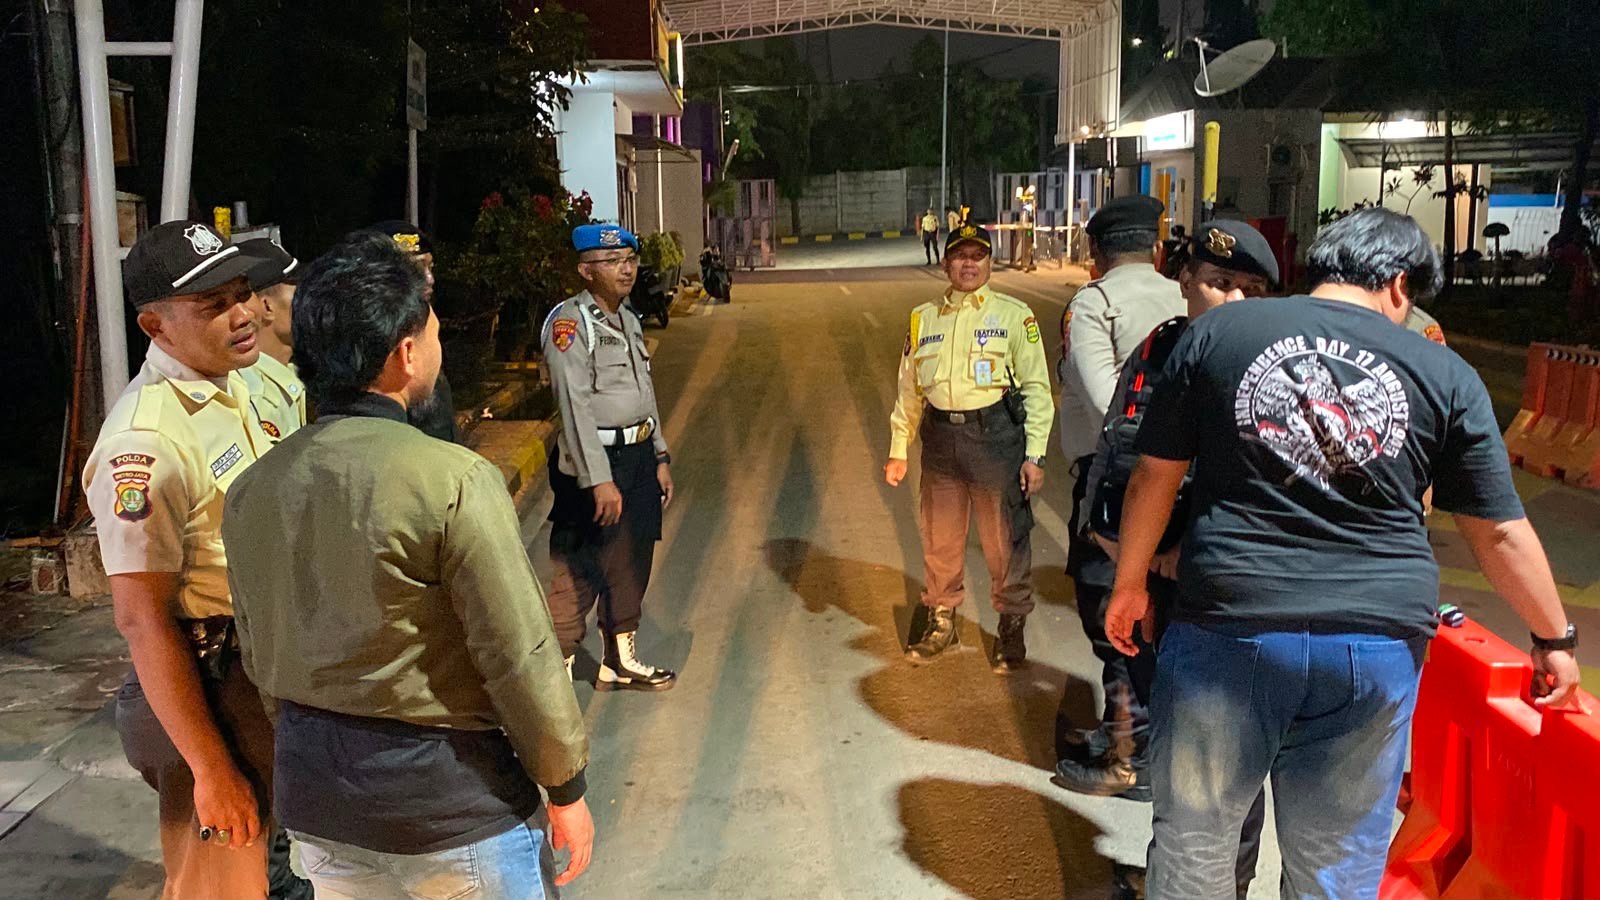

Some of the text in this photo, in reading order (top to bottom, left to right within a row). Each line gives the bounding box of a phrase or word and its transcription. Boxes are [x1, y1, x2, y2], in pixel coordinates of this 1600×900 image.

[1235, 335, 1307, 427] INDEPENDENCE
[1315, 336, 1350, 358] DAY
[1355, 349, 1376, 368] 17
[1370, 361, 1409, 421] AUGUST
[116, 454, 148, 465] POLDA
